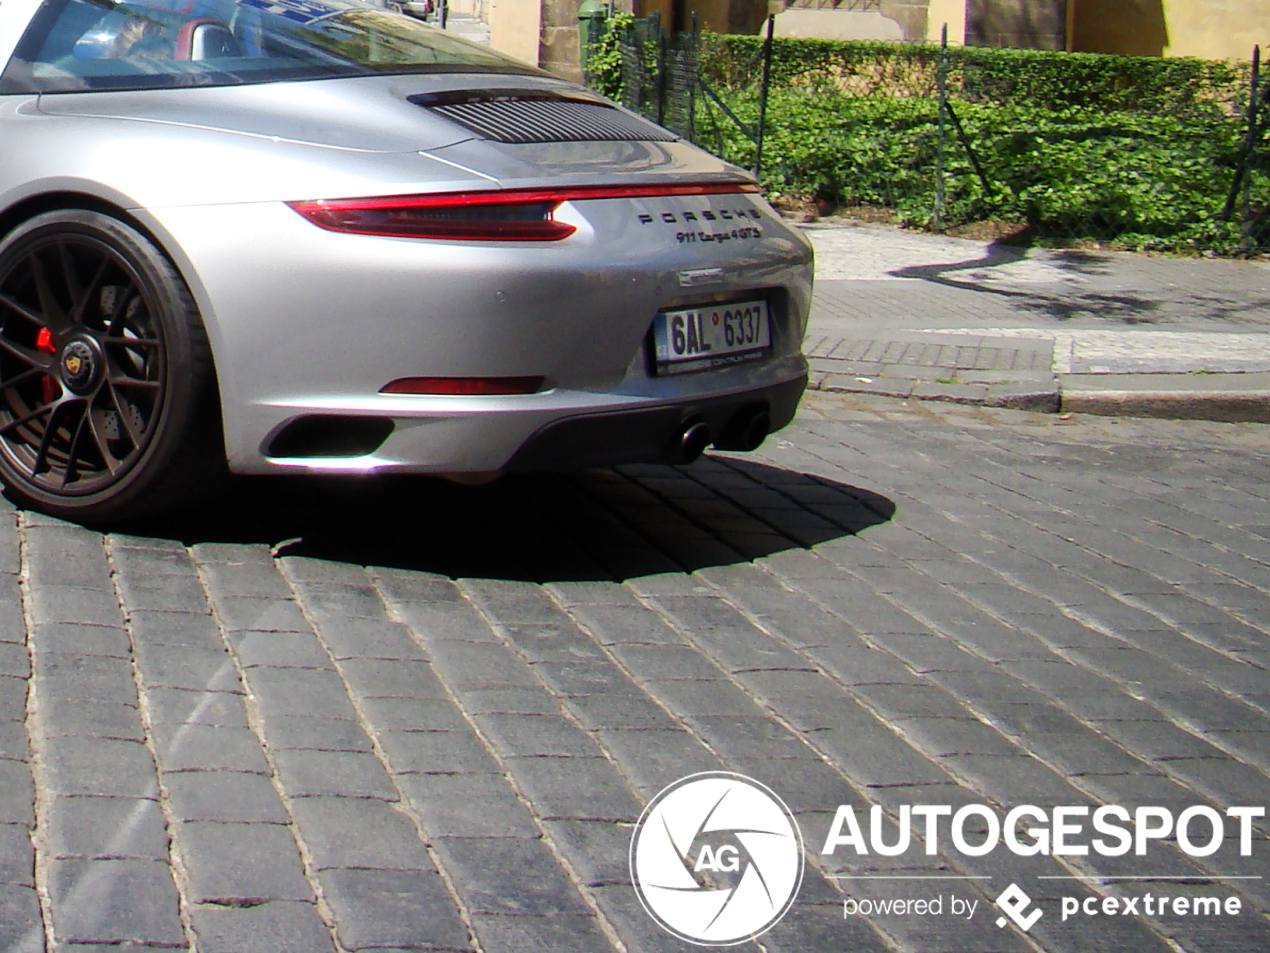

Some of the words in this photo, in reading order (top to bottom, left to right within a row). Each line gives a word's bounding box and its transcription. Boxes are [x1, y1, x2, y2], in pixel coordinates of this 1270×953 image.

[638, 209, 762, 225] PORSCHE
[676, 231, 695, 243] 911
[738, 227, 761, 239] GTS
[670, 311, 711, 355] 6AL
[723, 306, 761, 347] 6337
